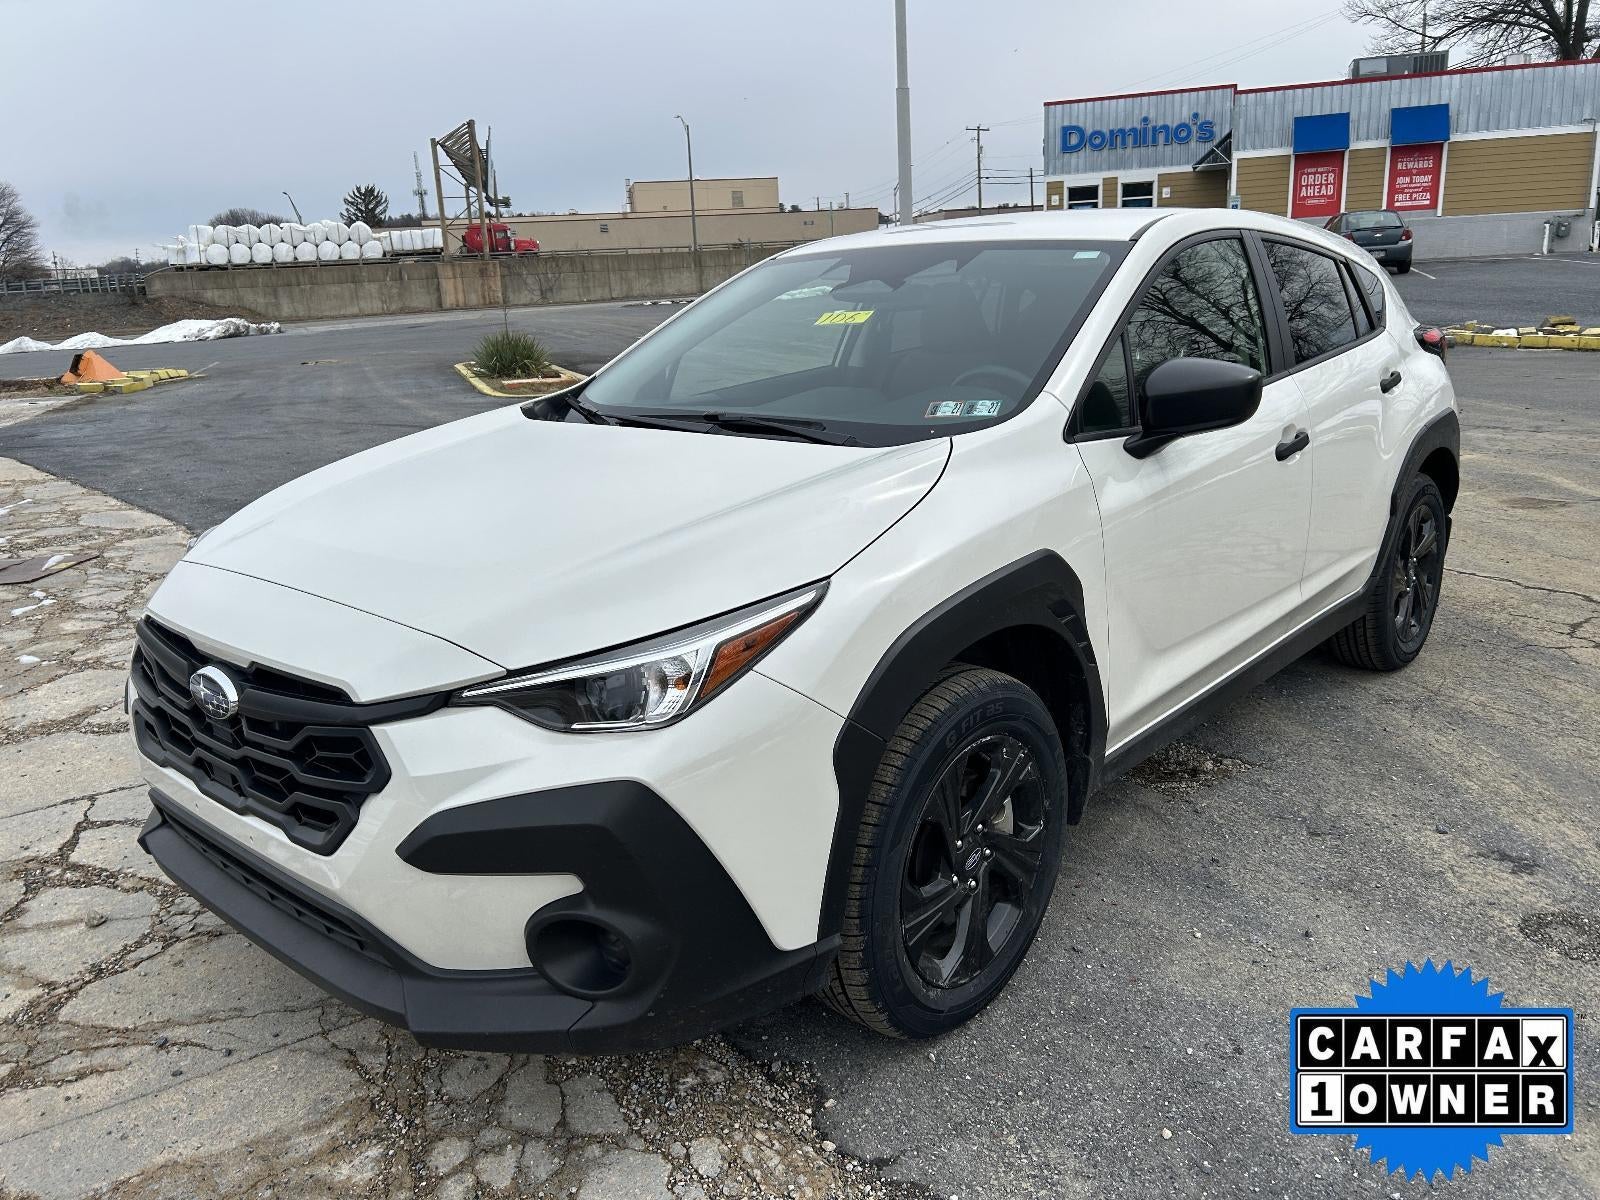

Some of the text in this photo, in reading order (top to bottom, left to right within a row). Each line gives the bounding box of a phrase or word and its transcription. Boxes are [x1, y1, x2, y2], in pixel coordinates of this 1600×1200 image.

[1061, 112, 1216, 154] Domino's
[1397, 160, 1433, 170] REWARDS
[1301, 173, 1335, 186] ORDER
[1396, 174, 1433, 185] JOIN TODAY
[1300, 184, 1334, 197] AHEAD
[1394, 192, 1431, 202] FREE PIZZA
[961, 708, 984, 734] FIT
